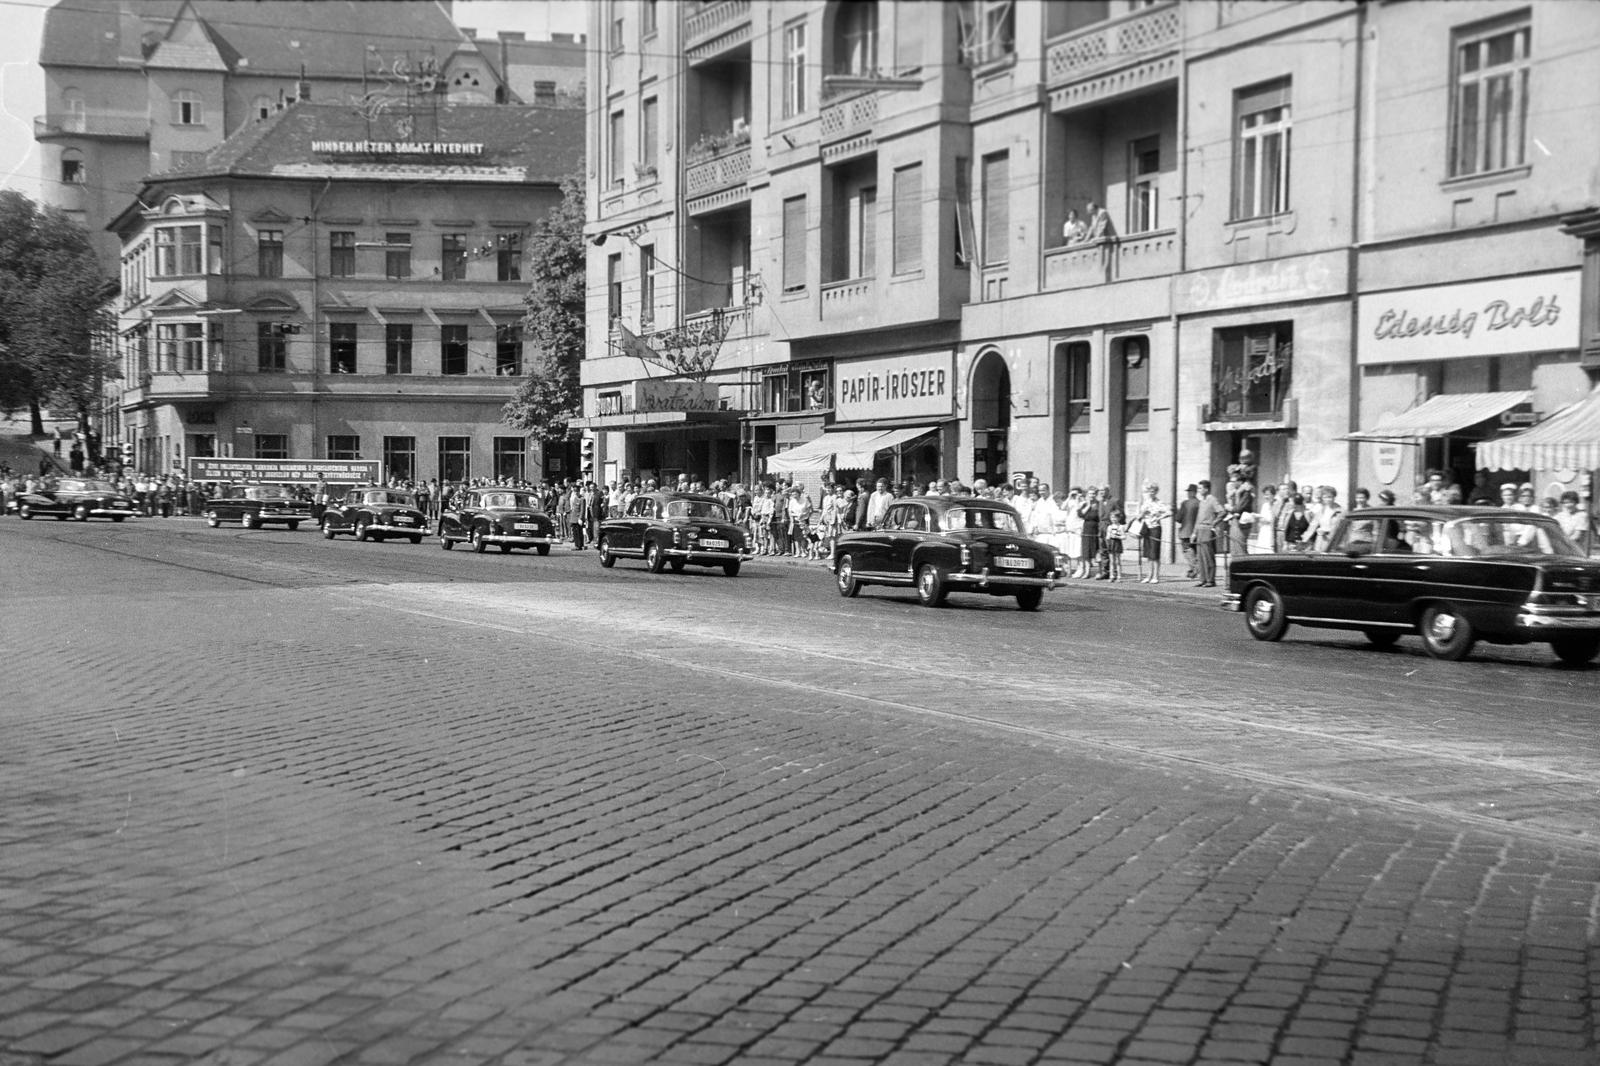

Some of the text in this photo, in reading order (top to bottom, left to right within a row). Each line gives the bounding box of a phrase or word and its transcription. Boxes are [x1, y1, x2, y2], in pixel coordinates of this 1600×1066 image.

[311, 140, 353, 152] MINDEN
[433, 142, 484, 155] NYERHET
[1483, 294, 1562, 331] Bolt
